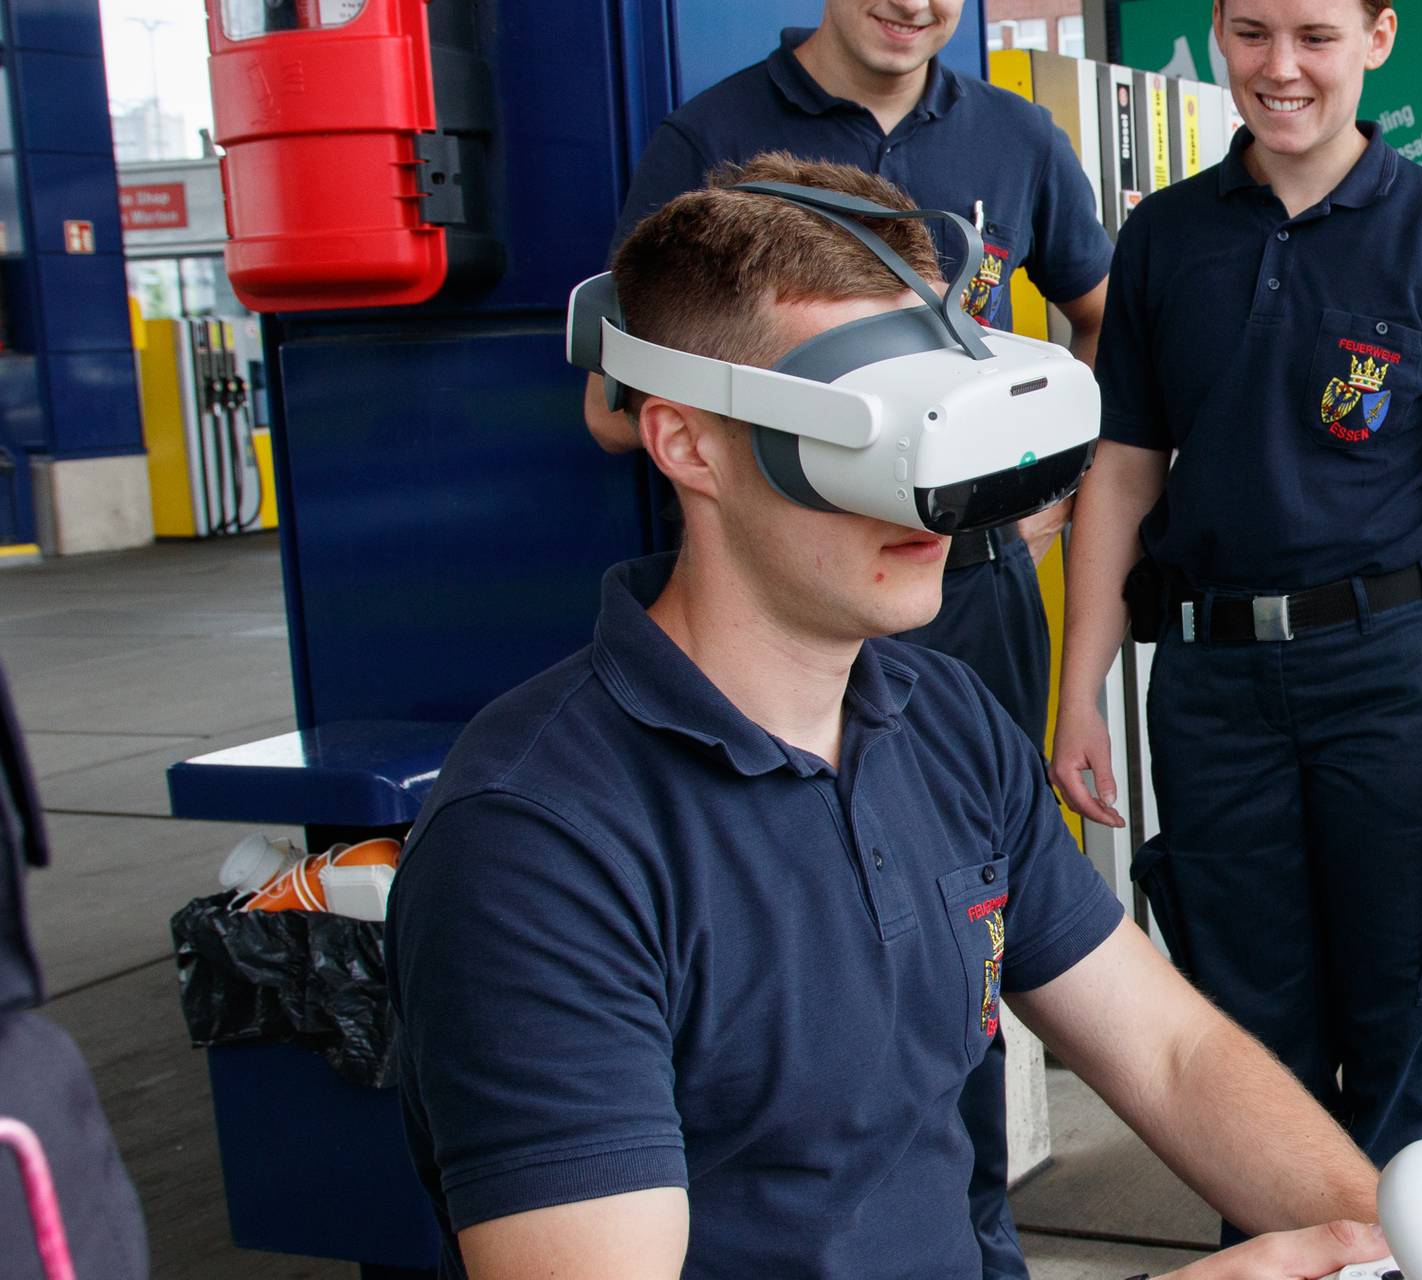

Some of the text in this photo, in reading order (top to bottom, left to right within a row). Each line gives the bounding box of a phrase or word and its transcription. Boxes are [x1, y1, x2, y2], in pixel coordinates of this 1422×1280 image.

[1377, 104, 1416, 135] ling
[1120, 114, 1130, 159] Diesel
[1338, 339, 1401, 365] FEUERWEHR
[1329, 421, 1370, 442] ESSEN
